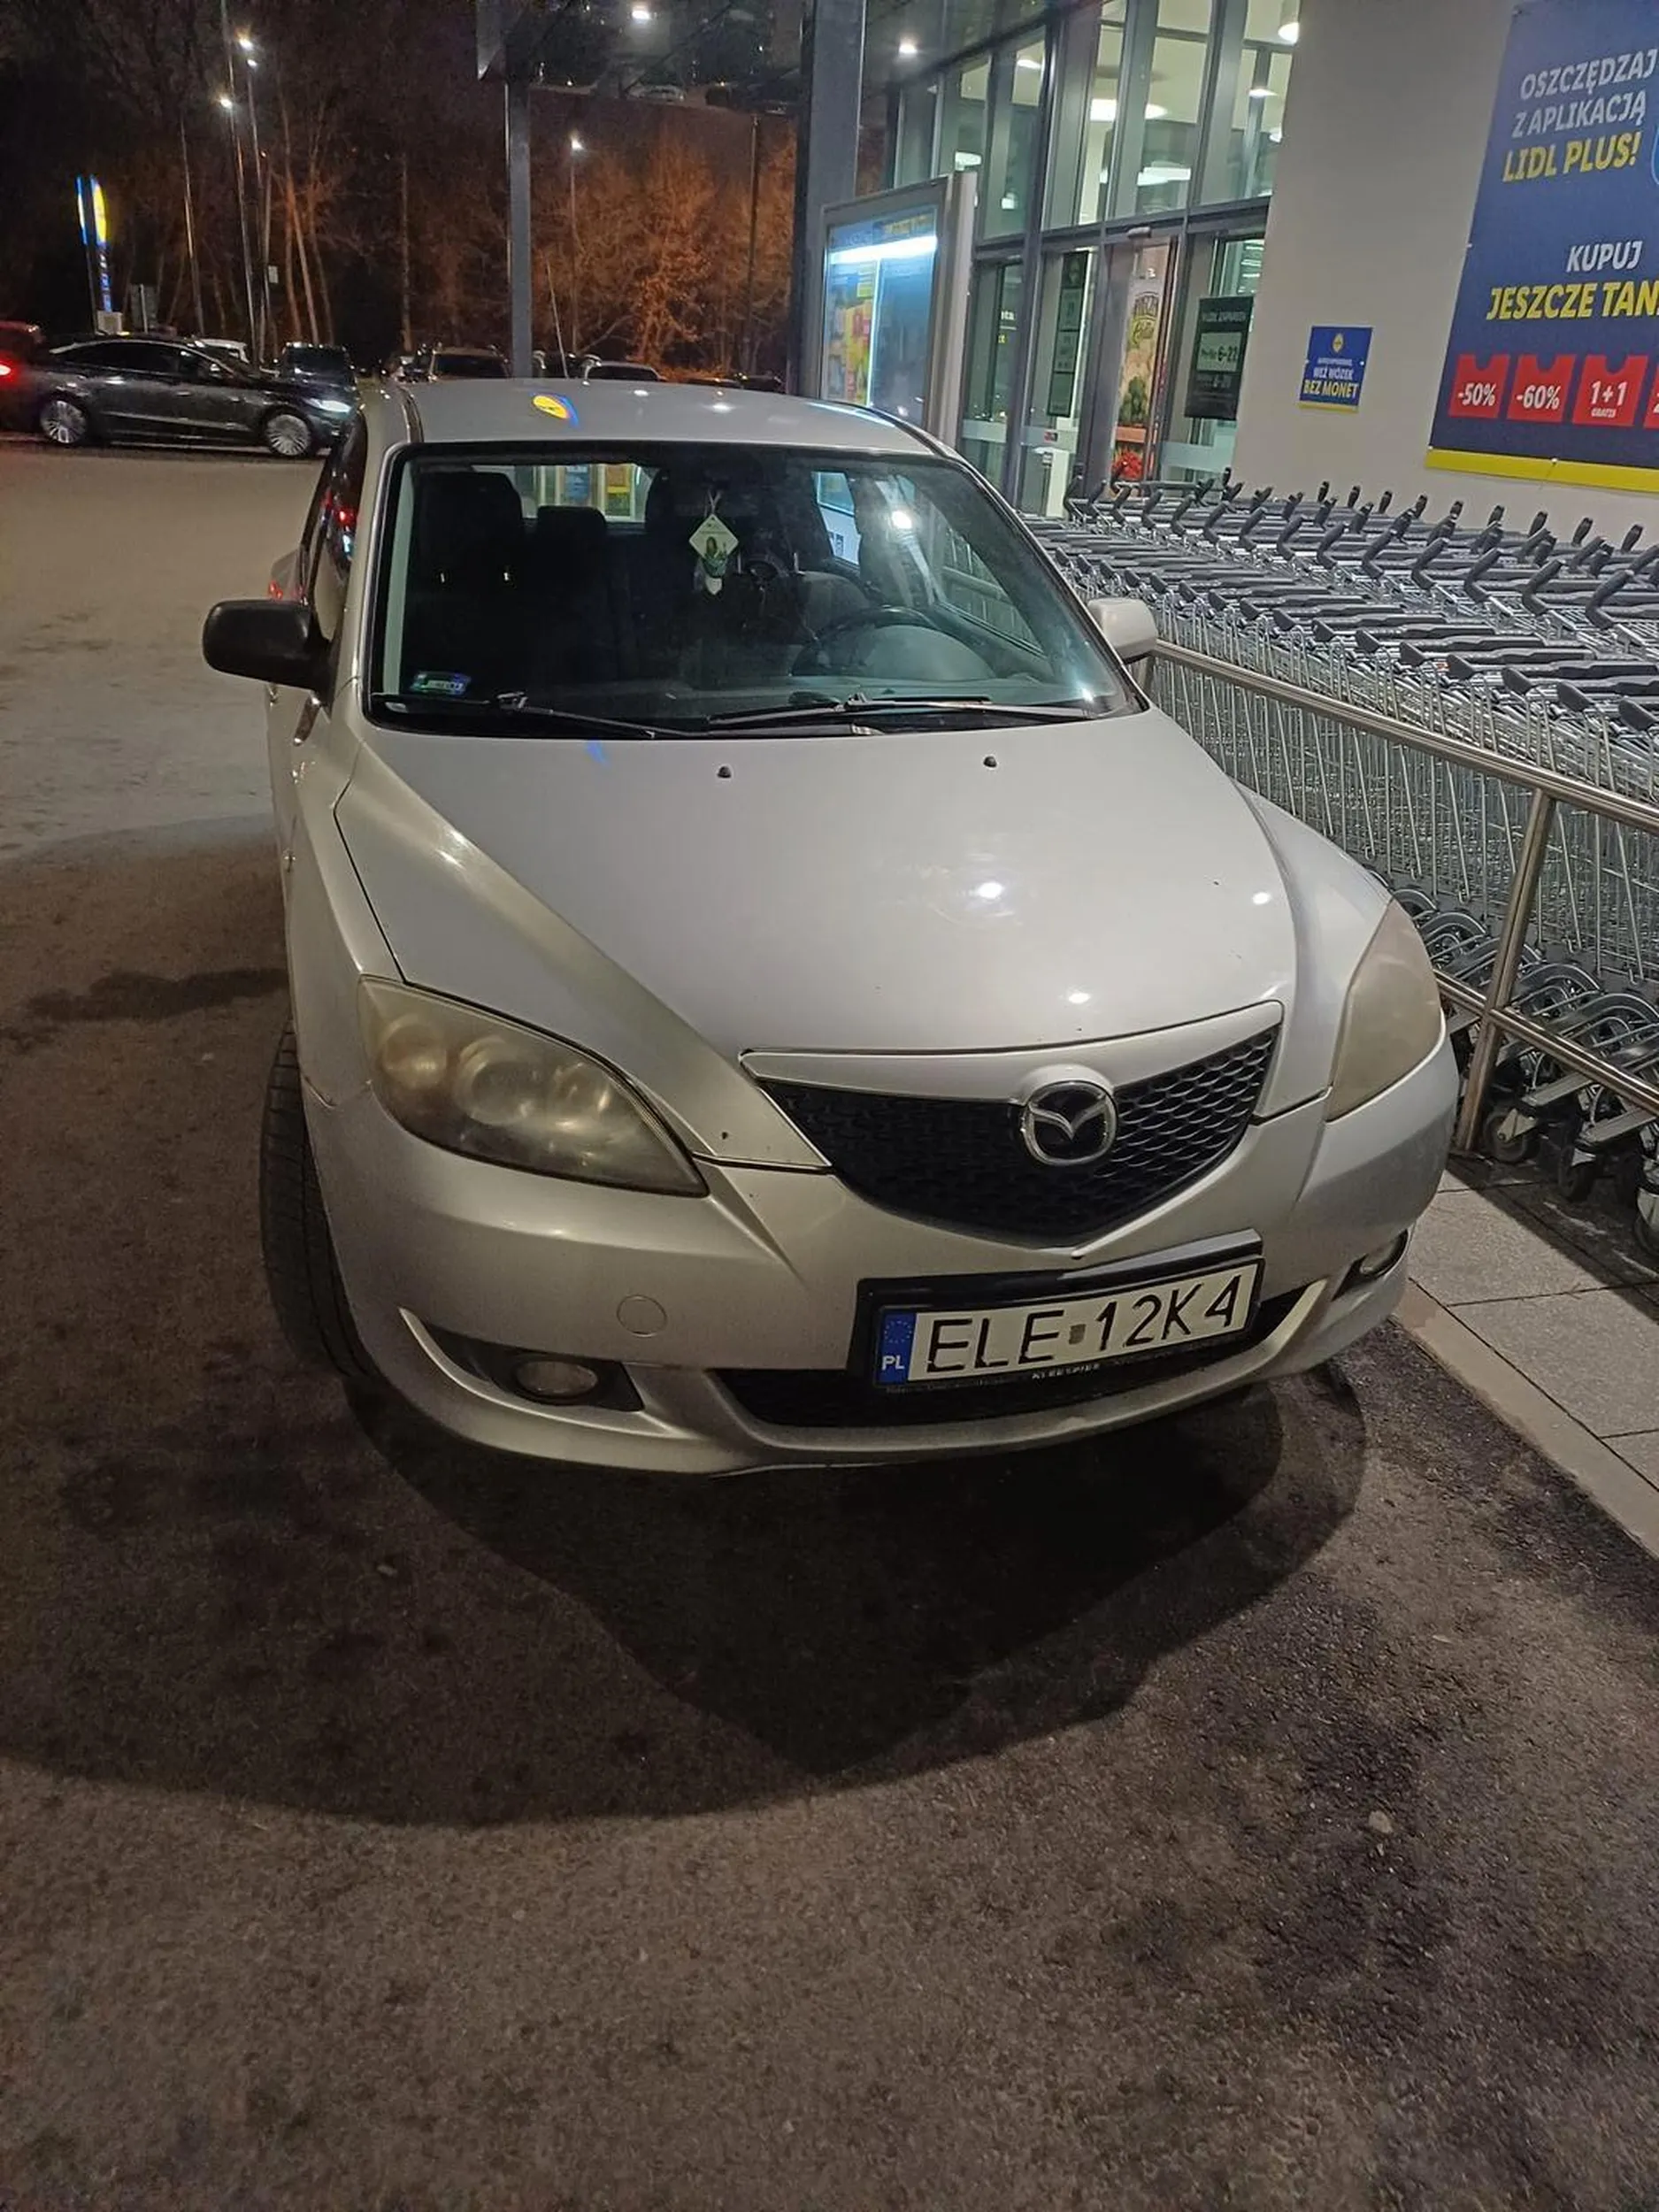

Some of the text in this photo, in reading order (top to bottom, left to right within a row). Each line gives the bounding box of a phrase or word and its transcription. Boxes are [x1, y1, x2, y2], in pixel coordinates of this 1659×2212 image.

[1520, 48, 1658, 99] OSZCZĘDZAJ
[1511, 89, 1647, 138] Z APLIKACJĄ
[1502, 131, 1643, 182] LIDL PLUS!
[1566, 241, 1643, 273] KUPUJ
[1486, 280, 1659, 320] JESZCZE TAN
[1303, 379, 1360, 398] BEZ MONET
[1457, 382, 1495, 406] -50%
[1516, 385, 1561, 410] -60%
[1591, 380, 1628, 406] 1+1
[926, 1274, 1242, 1373] ELE 12K4
[880, 1356, 905, 1371] PL
